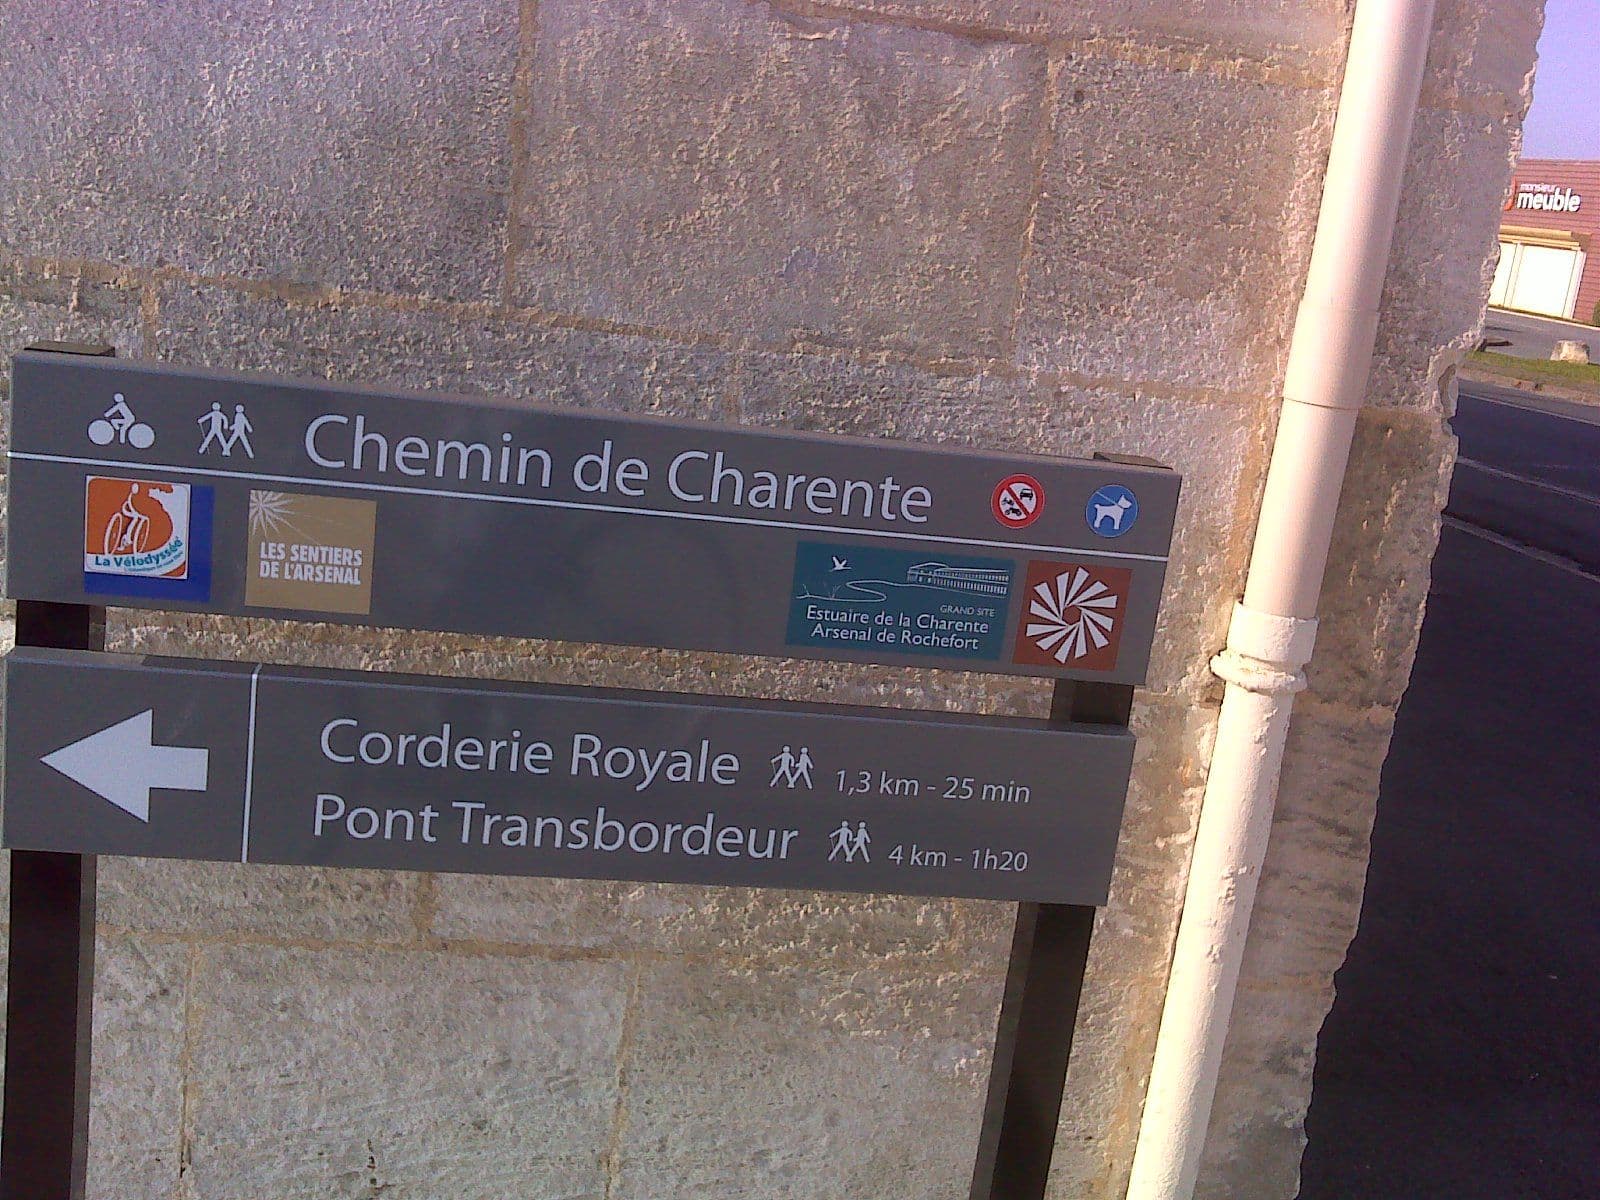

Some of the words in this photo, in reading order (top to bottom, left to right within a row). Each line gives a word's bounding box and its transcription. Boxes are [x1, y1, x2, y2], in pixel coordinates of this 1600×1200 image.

[1517, 188, 1581, 212] meuble
[304, 413, 552, 488] Chemin
[572, 440, 650, 496] de
[667, 450, 932, 523] Charente
[95, 556, 110, 566] La
[260, 541, 286, 560] LES
[290, 544, 363, 566] SENTIERS
[260, 560, 279, 579] DE
[284, 562, 361, 585] L'ARSENAL
[806, 604, 869, 624] Estuaire
[874, 611, 894, 627] de
[899, 613, 911, 627] la
[916, 614, 989, 634] Charente
[939, 604, 974, 615] GRAND
[976, 607, 996, 618] SITE
[810, 623, 871, 641] Arsenal
[876, 628, 896, 643] de
[900, 630, 979, 650] Rochefort
[320, 718, 554, 775] Corderie
[570, 733, 740, 792] Royale
[836, 769, 872, 796] 1,3
[879, 770, 920, 797] km
[942, 776, 975, 800] 25
[981, 780, 1031, 803] min
[313, 794, 439, 843] Pont
[451, 801, 799, 860] Transbordeur
[888, 845, 904, 866] 4
[909, 844, 947, 867] km
[970, 848, 1029, 873] 1h20
